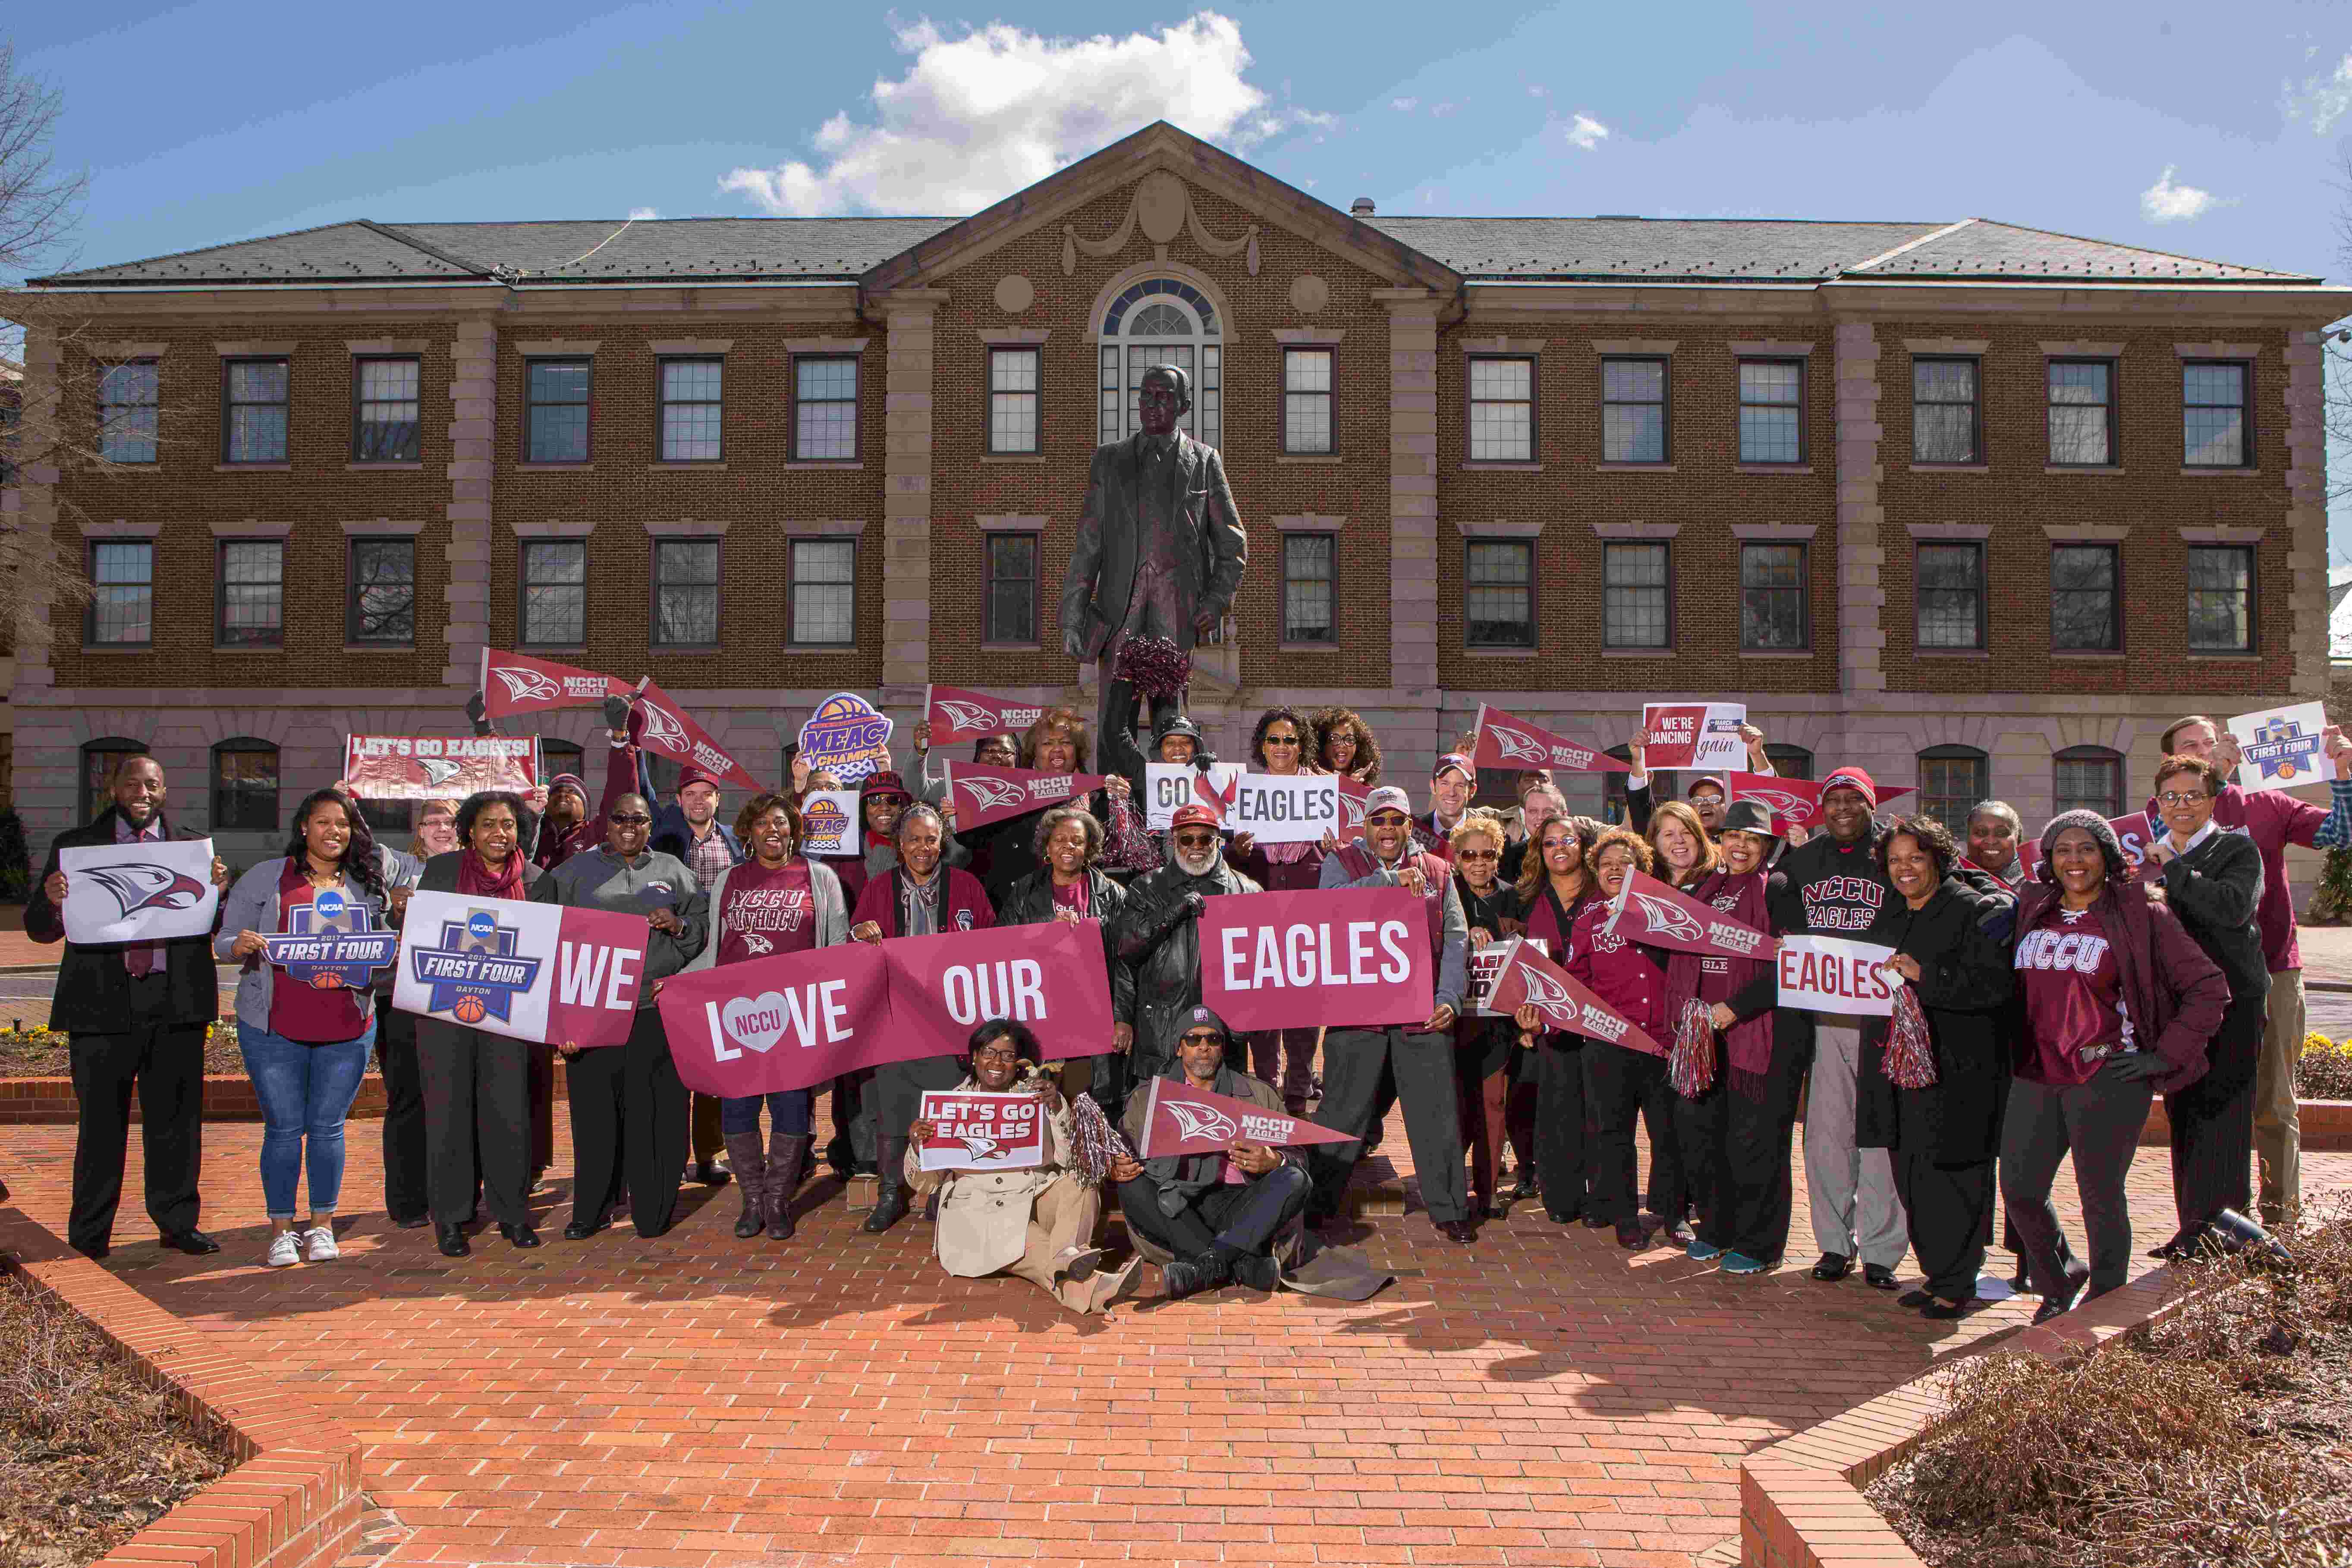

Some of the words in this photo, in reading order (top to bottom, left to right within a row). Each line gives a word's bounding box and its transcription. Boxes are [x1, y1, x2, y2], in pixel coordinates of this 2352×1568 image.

[563, 677, 608, 688] NCCU
[1001, 709, 1042, 719] NCCU
[1662, 716, 1694, 730] WE'RE
[352, 738, 411, 755] LET'S
[415, 738, 443, 756] GO
[803, 722, 887, 757] MEAC
[2252, 745, 2282, 760] FIRST
[2284, 739, 2312, 754] FOUR
[693, 740, 733, 770] NCCU
[694, 752, 724, 773] EAGLES
[817, 748, 878, 767] CHAMPS
[1550, 745, 1594, 762] NCCU
[1554, 756, 1588, 766] EAGLES
[1027, 775, 1073, 791] NCCU
[1034, 786, 1069, 795] EAGLES
[1157, 777, 1191, 808] GO
[1239, 789, 1335, 821] EAGLES
[1412, 827, 1439, 849] CCU
[727, 889, 805, 909] NCCU
[1802, 876, 1884, 908] NCCU
[1806, 906, 1875, 930] EAGLES
[470, 924, 494, 934] NCAA
[1706, 921, 1763, 946] NCCU
[276, 942, 333, 959] FIRST
[334, 941, 384, 959] FOUR
[1712, 935, 1753, 951] EAGLES
[2014, 928, 2109, 974] NCCU
[1222, 920, 1411, 990] EAGLES
[1702, 960, 1728, 970] GLE
[424, 957, 480, 979] FIRST
[480, 963, 526, 984] FOUR
[560, 941, 641, 1010] WE
[1780, 950, 1891, 1000] EAGLES
[456, 985, 491, 995] DAYTON
[943, 958, 1046, 1025] OUR
[735, 1009, 780, 1036] NCCU
[1582, 1003, 1629, 1034] NCCU
[1584, 1017, 1619, 1039] EAGLES
[928, 1102, 995, 1120] LET'S
[1002, 1104, 1035, 1120] GO
[937, 1121, 1031, 1139] EAGLES
[1241, 1115, 1295, 1133] NCCU
[1246, 1128, 1288, 1140] EAGLES
